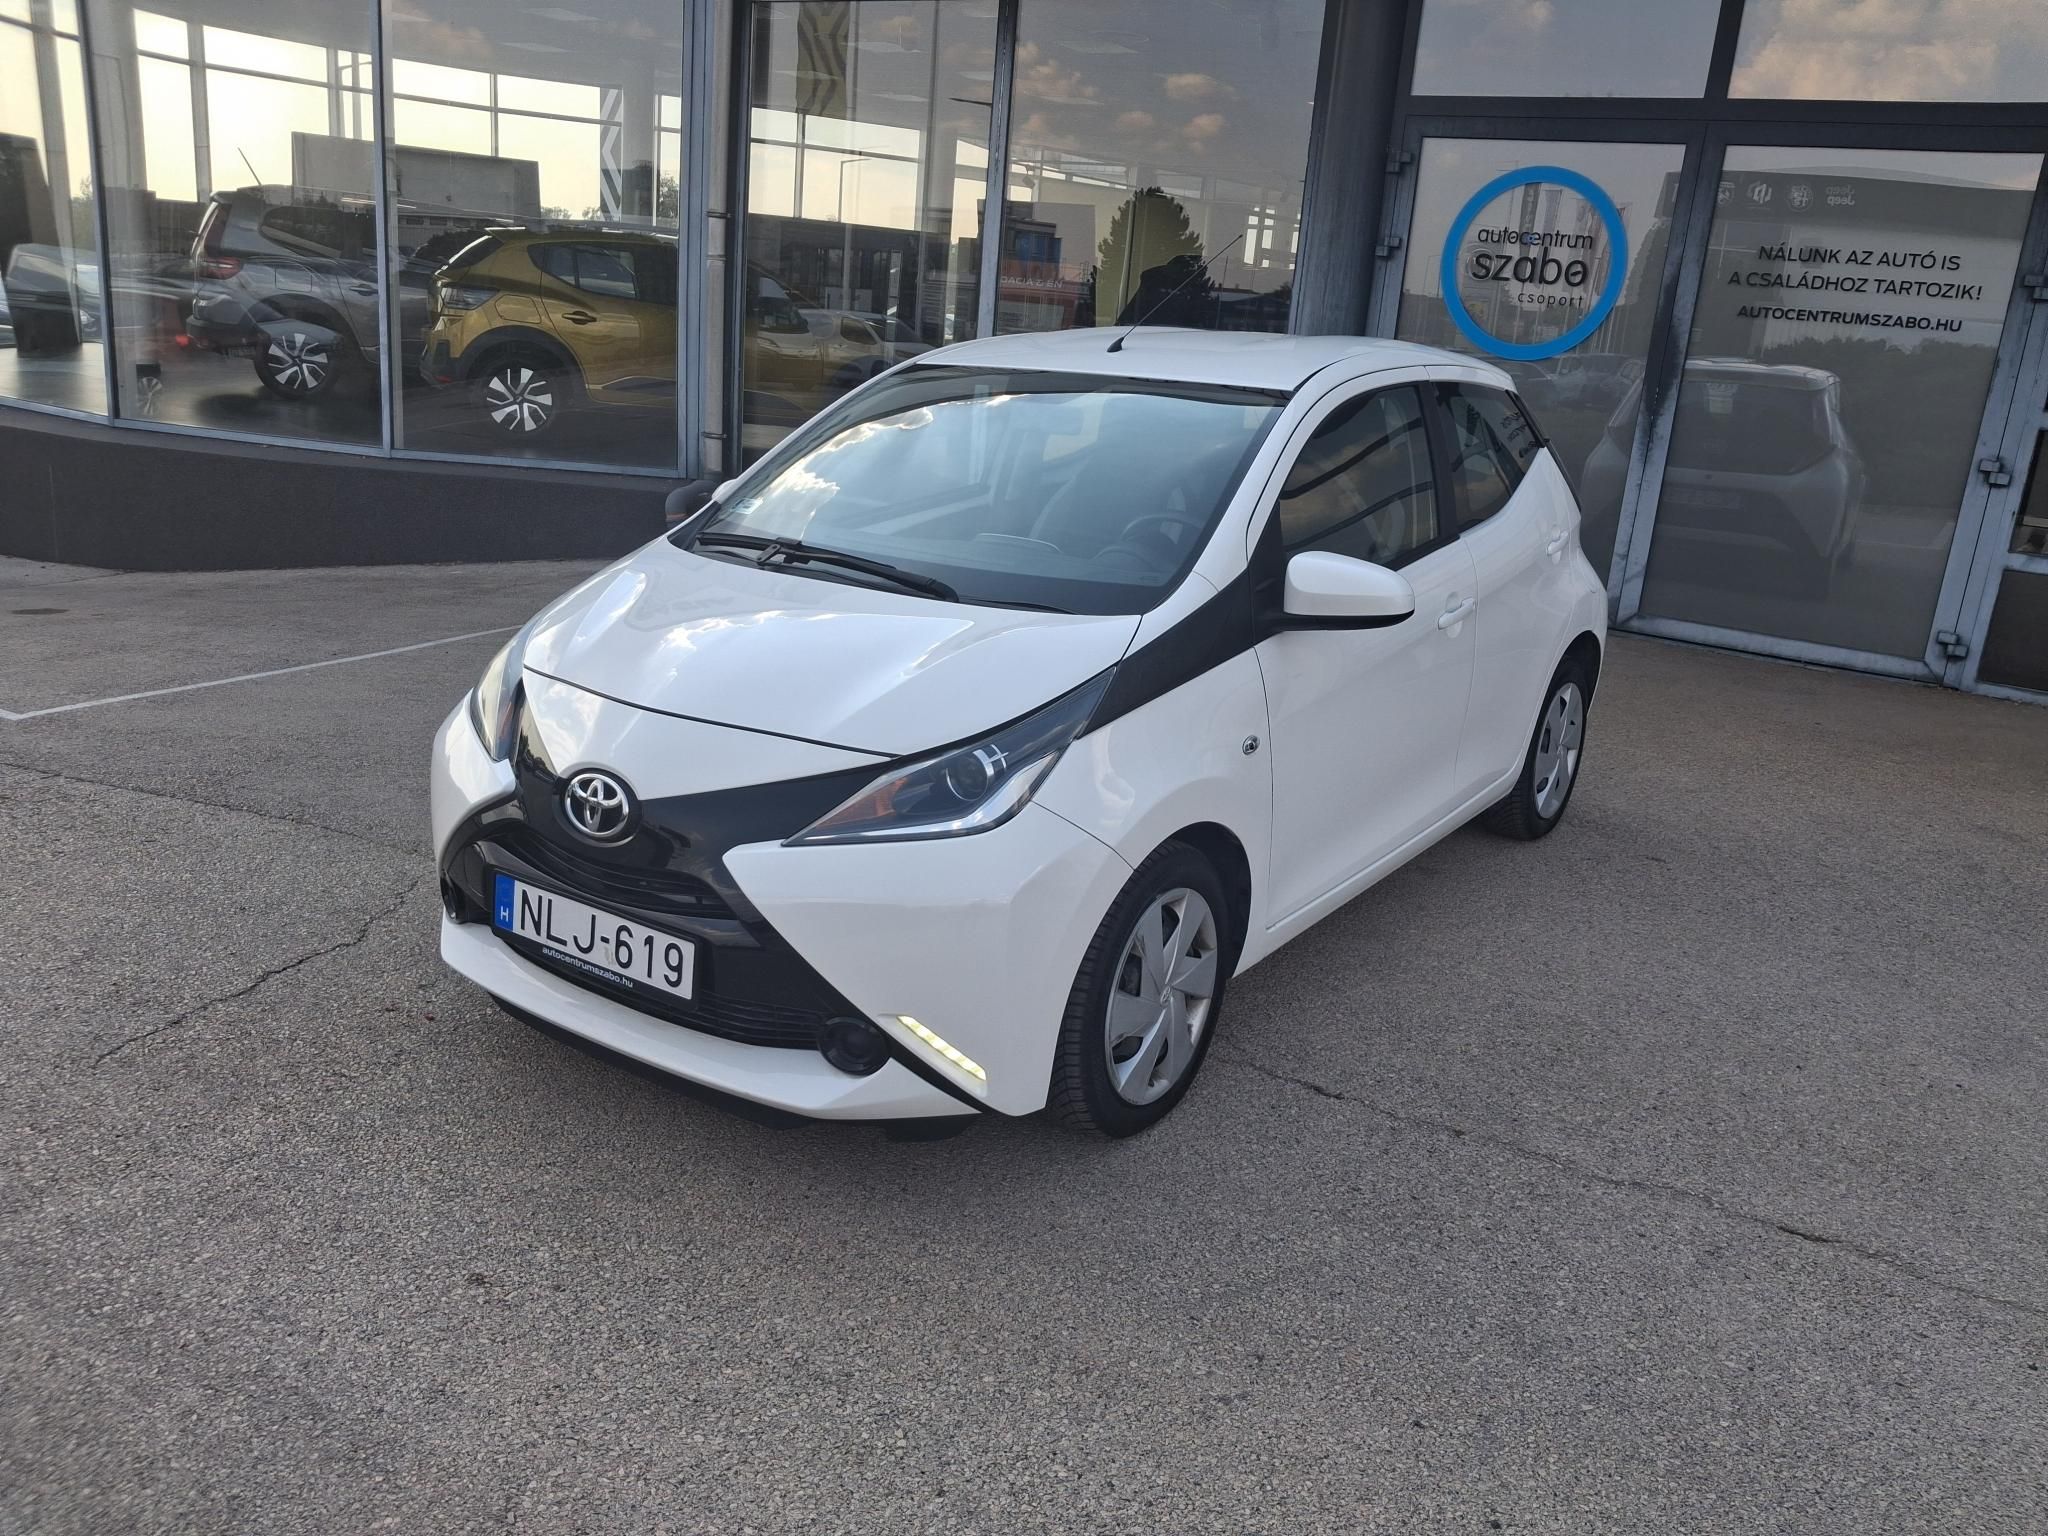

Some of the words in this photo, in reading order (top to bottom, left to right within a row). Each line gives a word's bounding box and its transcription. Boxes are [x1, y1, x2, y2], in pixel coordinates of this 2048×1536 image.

[1477, 226, 1594, 250] autocentrum
[1757, 242, 1842, 265] NÁLUNK
[1845, 250, 1874, 266] AZ
[1876, 251, 1937, 270] AUTÓ
[1940, 255, 1961, 271] IS
[1727, 271, 1742, 286] A
[1745, 271, 1870, 293] CSALÁDHOZ
[1873, 278, 1983, 301] TARTOZIK!
[1517, 292, 1584, 309] csoport
[1736, 305, 1963, 333] AUTOCENTRUMSZABO.HU
[500, 906, 509, 922] H
[519, 888, 684, 988] NLJ-619
[542, 946, 634, 989] autocentrumszabo.hu
